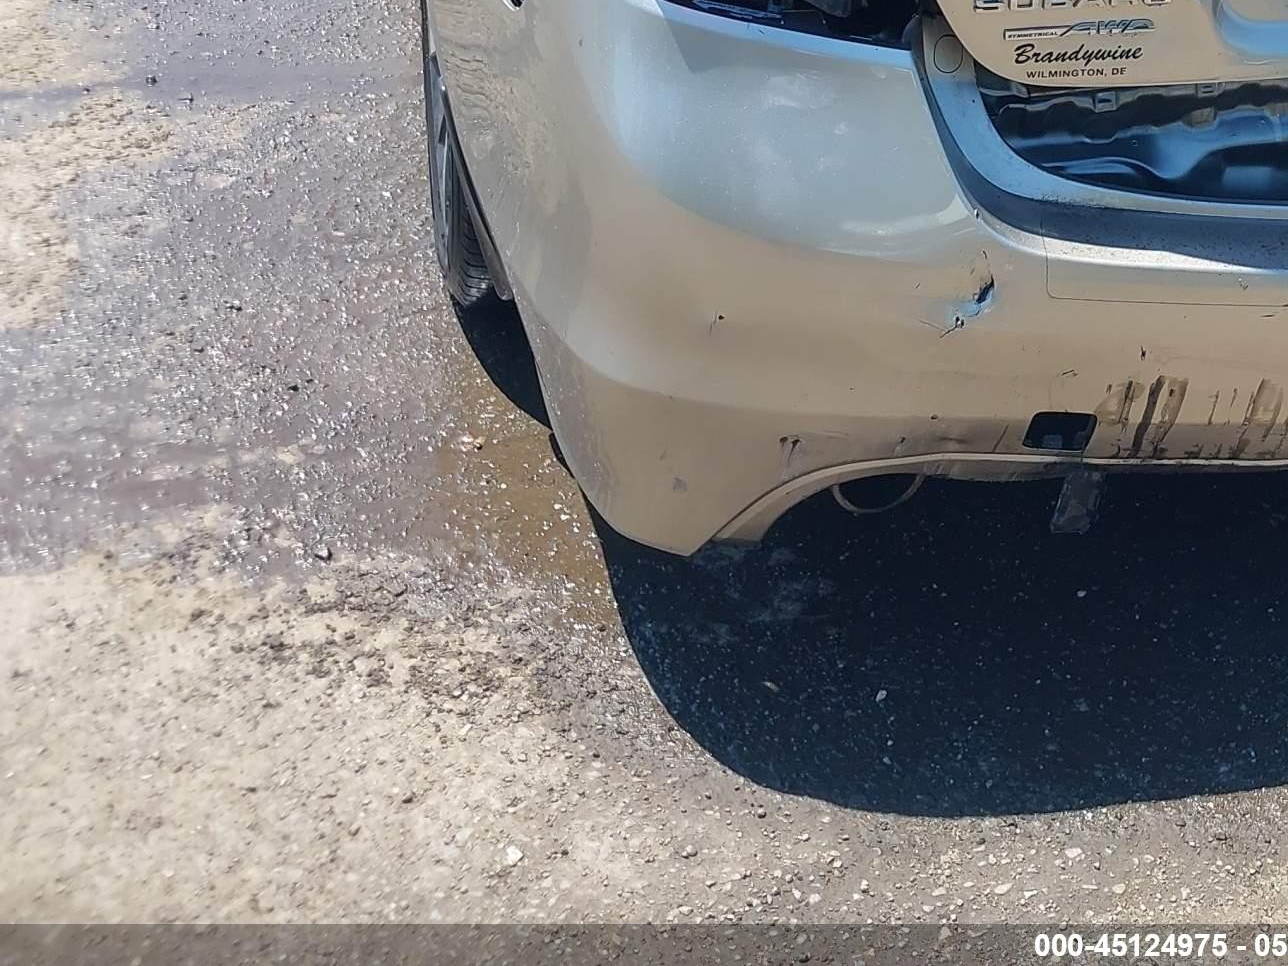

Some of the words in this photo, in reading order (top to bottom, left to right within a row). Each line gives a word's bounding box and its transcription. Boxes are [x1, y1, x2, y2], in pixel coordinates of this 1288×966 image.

[1007, 31, 1059, 39] SYMMETRICAL
[1064, 18, 1156, 36] AWD
[1013, 43, 1144, 67] Brandywine
[1026, 68, 1108, 79] WILMINGTON,
[1112, 67, 1128, 76] DE
